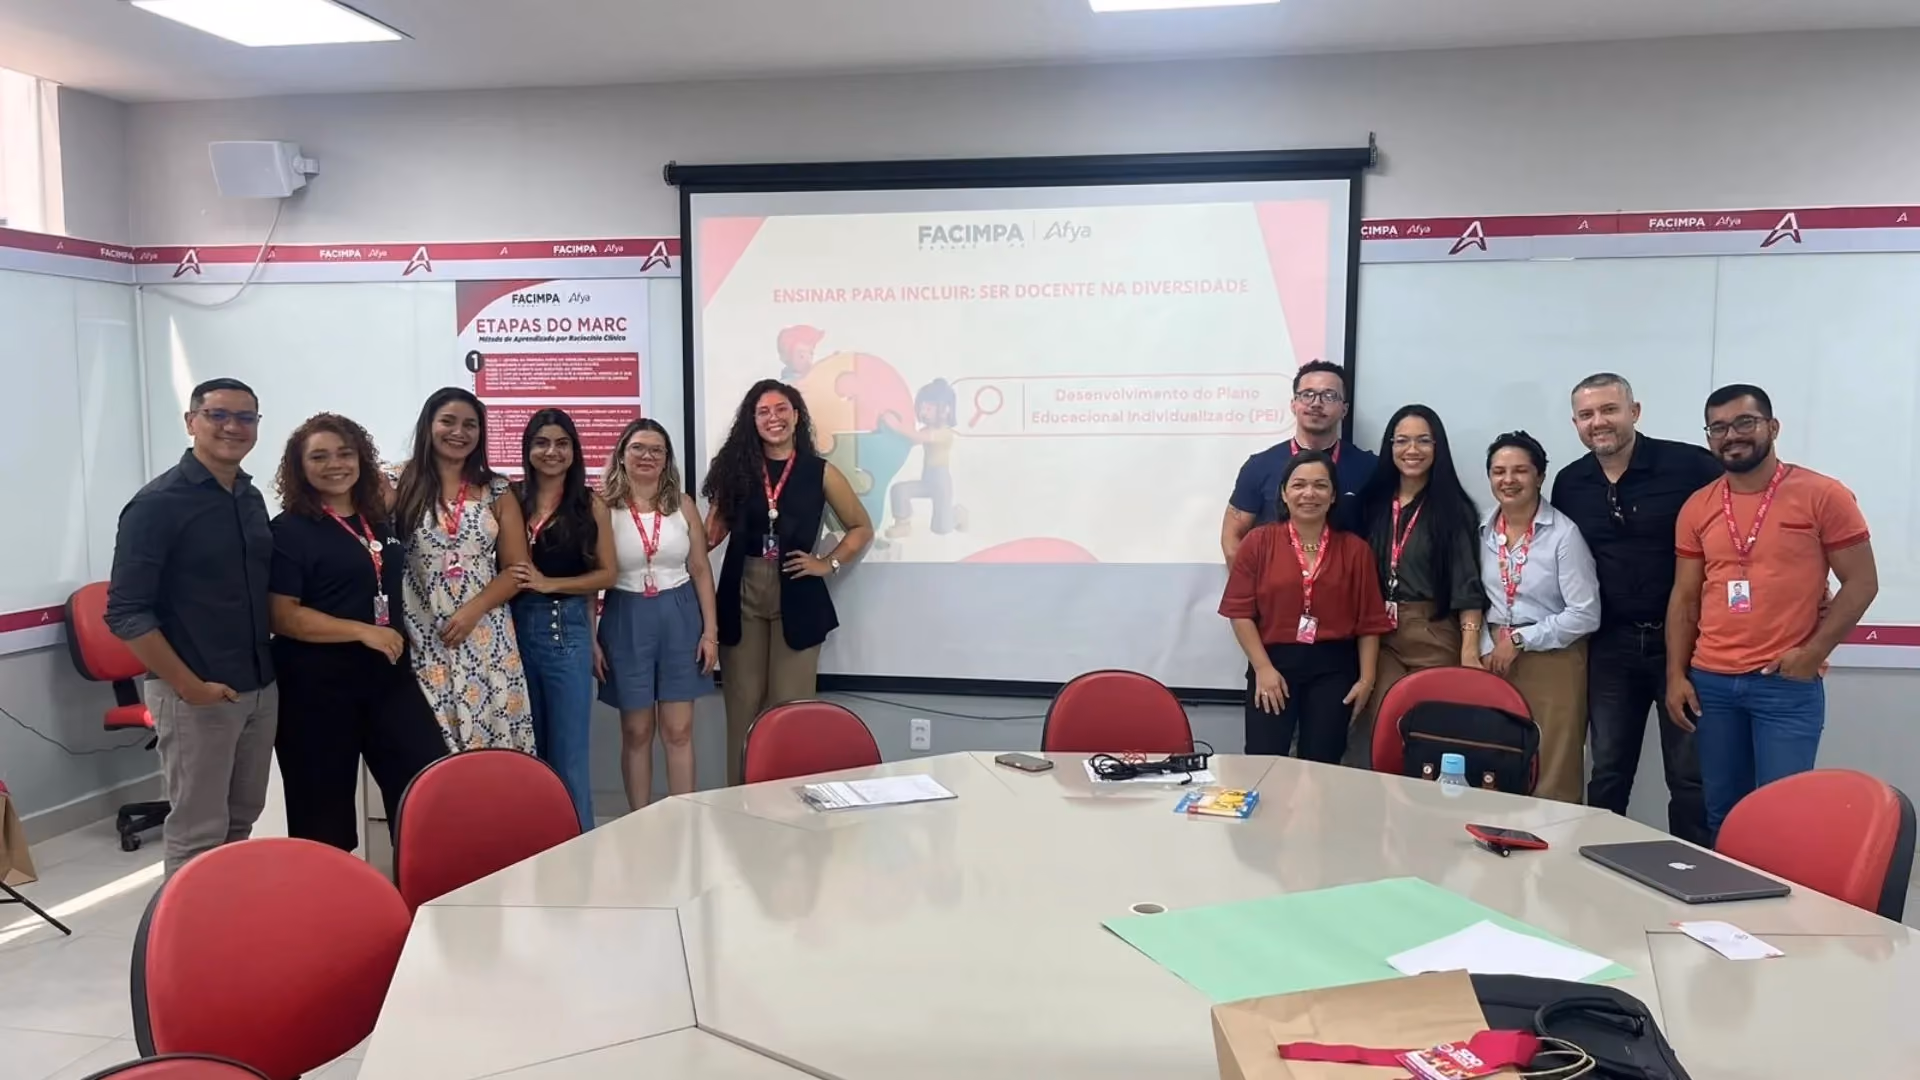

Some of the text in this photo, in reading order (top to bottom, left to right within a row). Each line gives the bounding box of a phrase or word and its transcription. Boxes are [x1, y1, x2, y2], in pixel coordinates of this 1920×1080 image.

[1649, 216, 1741, 228] FACIMPA Afya
[918, 220, 1091, 244] FACIMPA Afya
[1406, 224, 1431, 236] Afya
[100, 247, 134, 260] FACIMPA
[319, 248, 388, 258] FACIMPA Afya
[553, 243, 624, 254] FACIMPA Afya
[773, 278, 1249, 303] ENSINAR PARA INCLUIR: SER DOCENTE NA DIVERSIDADE
[512, 293, 591, 304] FACIMPA Afya
[477, 317, 627, 333] ETAPAS DO MARC
[471, 354, 479, 370] 1
[1055, 386, 1260, 402] Desenvolvimento do Plano
[1031, 408, 1285, 424] Educacional Individualizado (PEI)
